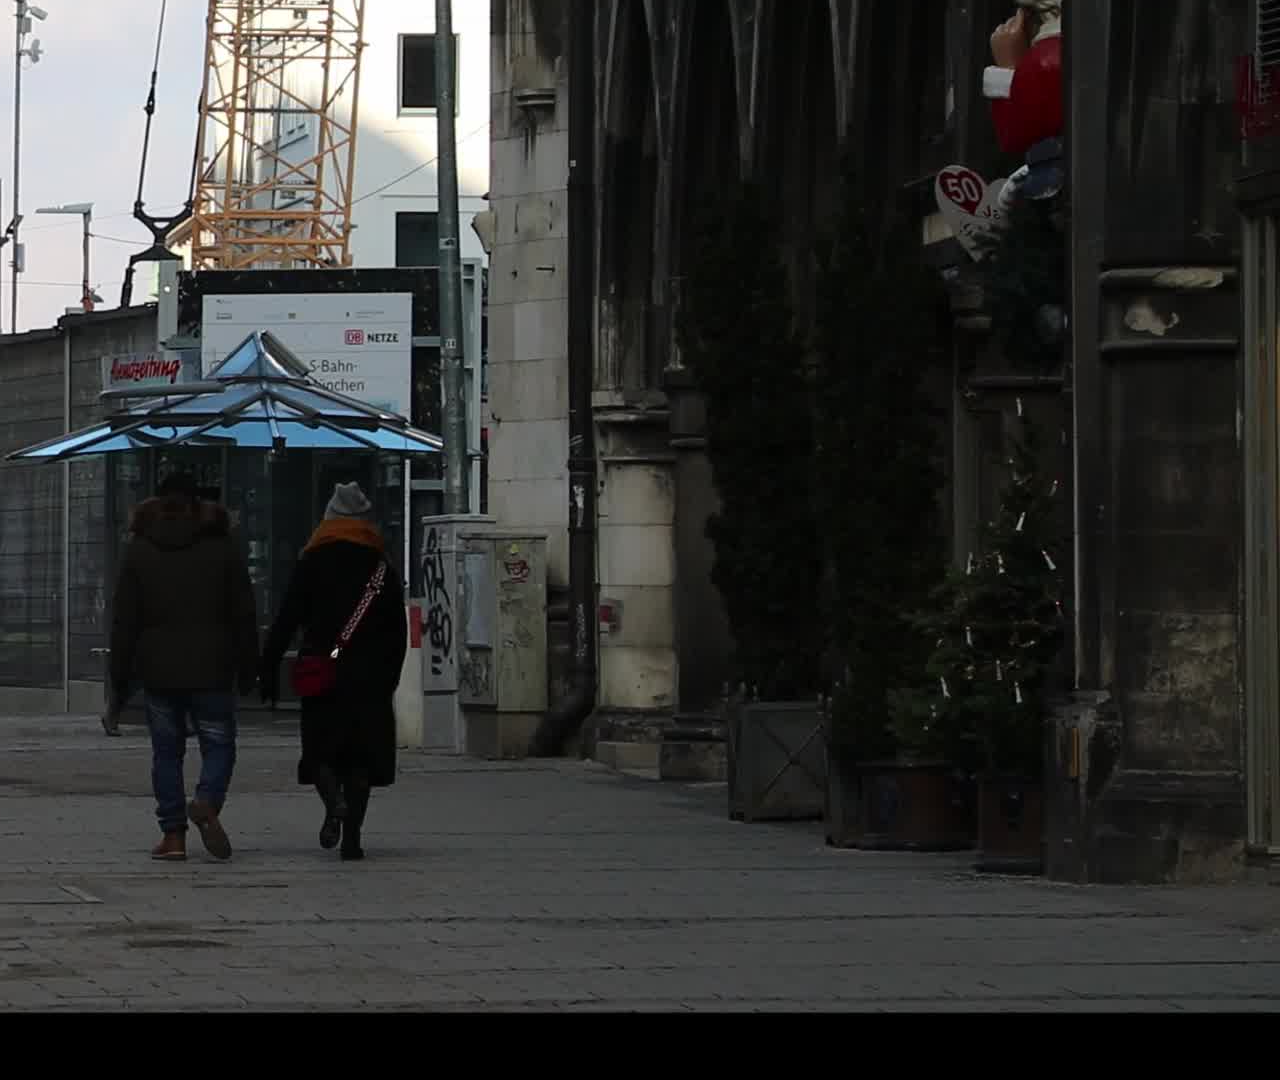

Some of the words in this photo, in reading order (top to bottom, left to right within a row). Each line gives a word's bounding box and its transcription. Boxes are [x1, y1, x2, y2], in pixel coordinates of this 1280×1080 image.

[947, 178, 980, 203] 50
[367, 333, 399, 343] NETZE
[310, 360, 359, 373] S-Bahn-
